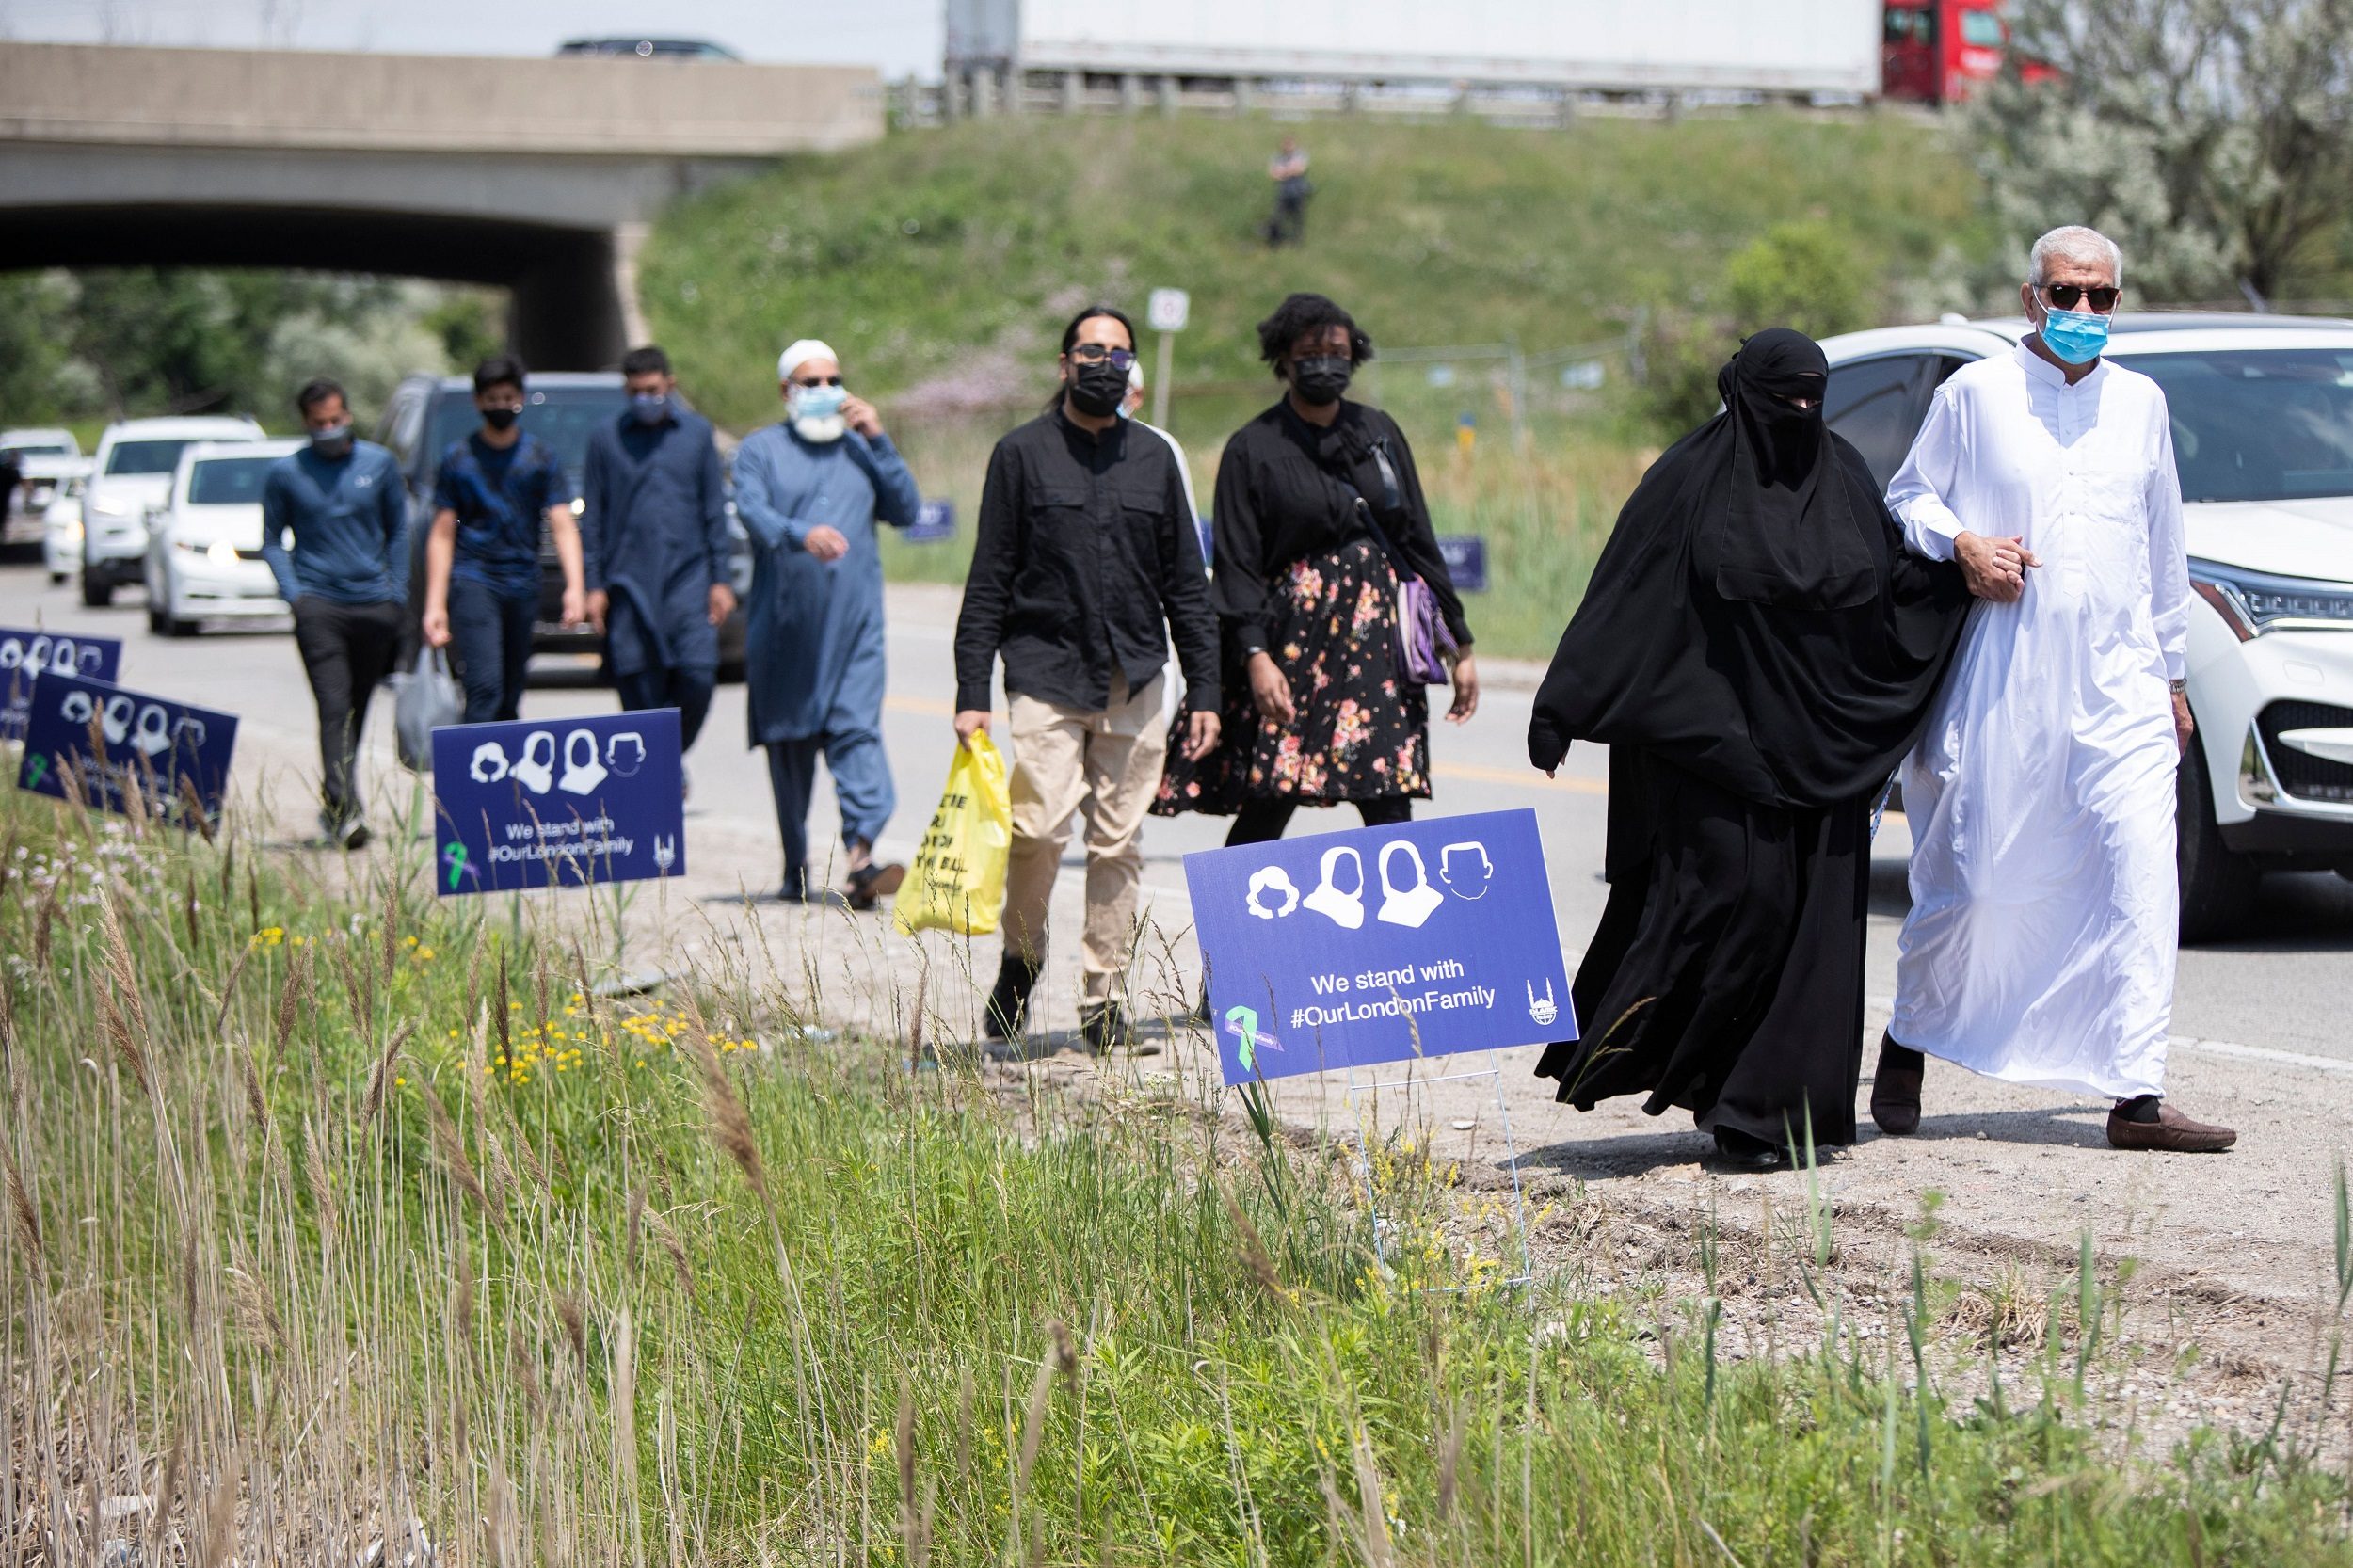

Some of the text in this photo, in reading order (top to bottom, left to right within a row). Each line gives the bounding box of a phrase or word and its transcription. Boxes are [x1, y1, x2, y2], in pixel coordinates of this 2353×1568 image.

[505, 823, 534, 840] We
[537, 818, 580, 838] stand
[1311, 958, 1465, 995] We stand with
[1290, 984, 1496, 1030] #OurLondonFamily
